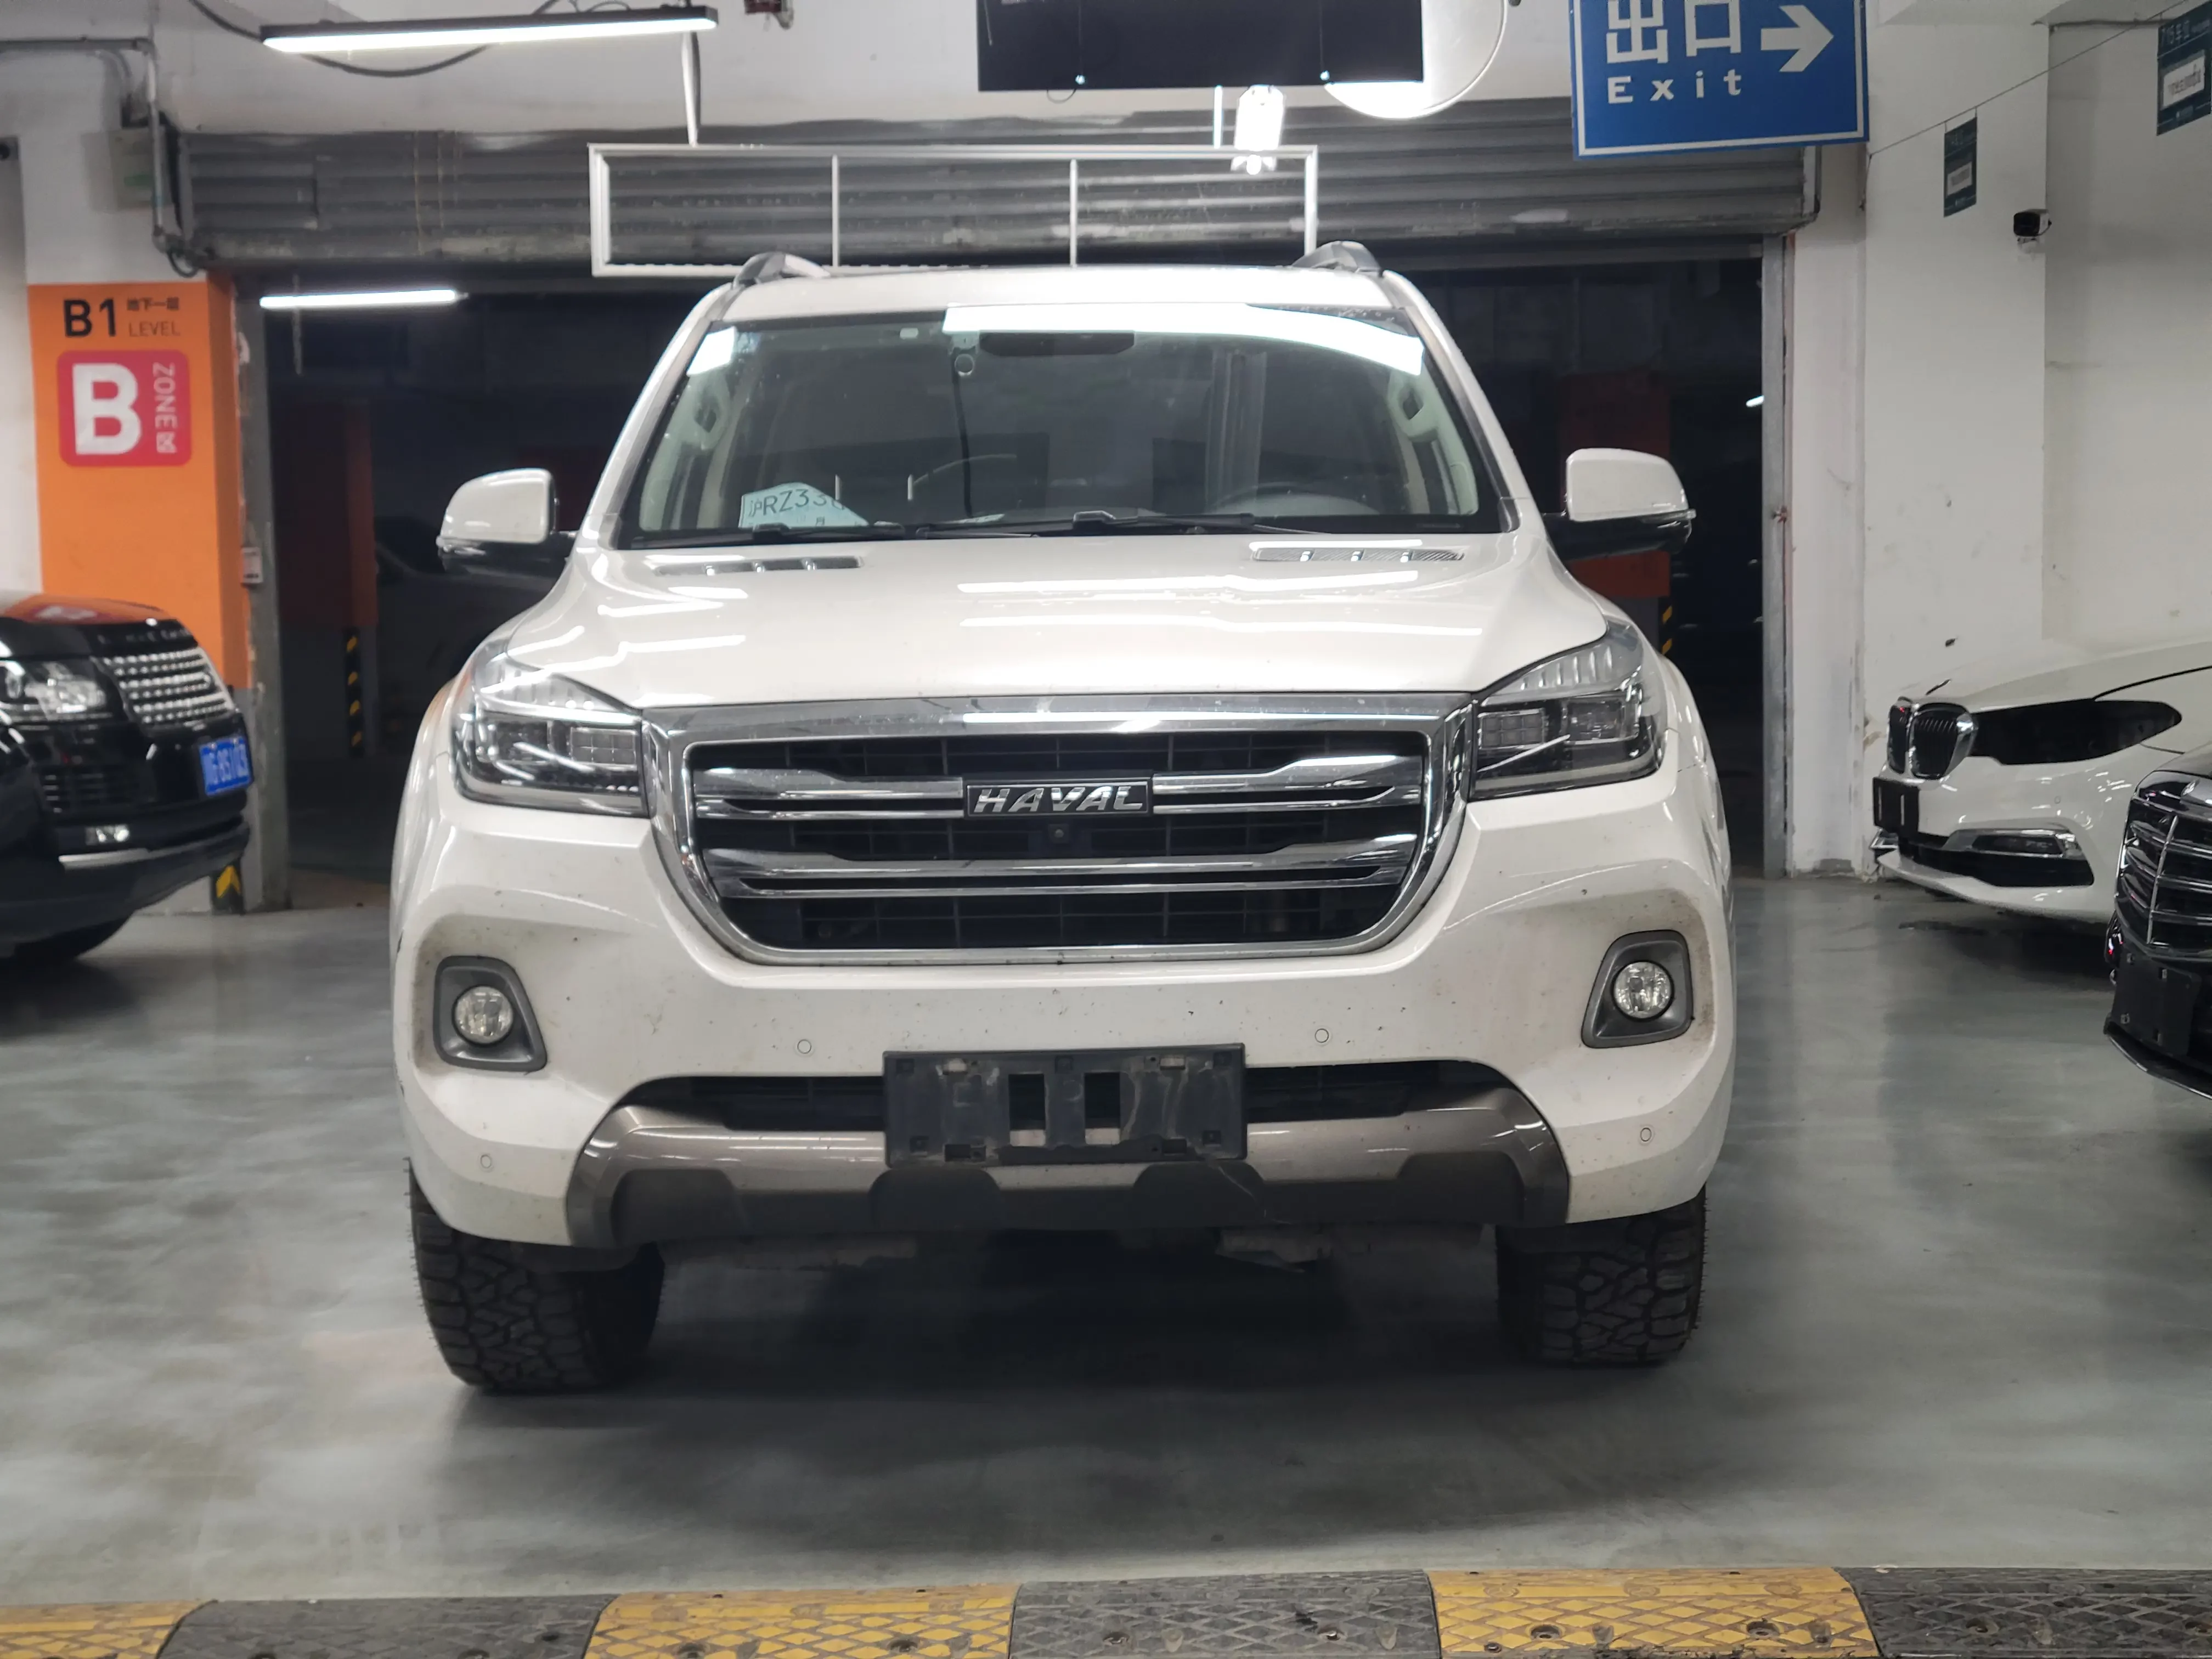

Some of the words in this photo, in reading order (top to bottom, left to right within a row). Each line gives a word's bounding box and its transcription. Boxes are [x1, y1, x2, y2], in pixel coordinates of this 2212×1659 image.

[1606, 0, 1742, 64] 出口
[1607, 69, 1742, 104] Exit
[63, 298, 117, 337] B1
[128, 321, 181, 337] LEVEL
[72, 362, 143, 455] B
[152, 362, 178, 429] ZONE
[973, 785, 1143, 813] HAVAL
